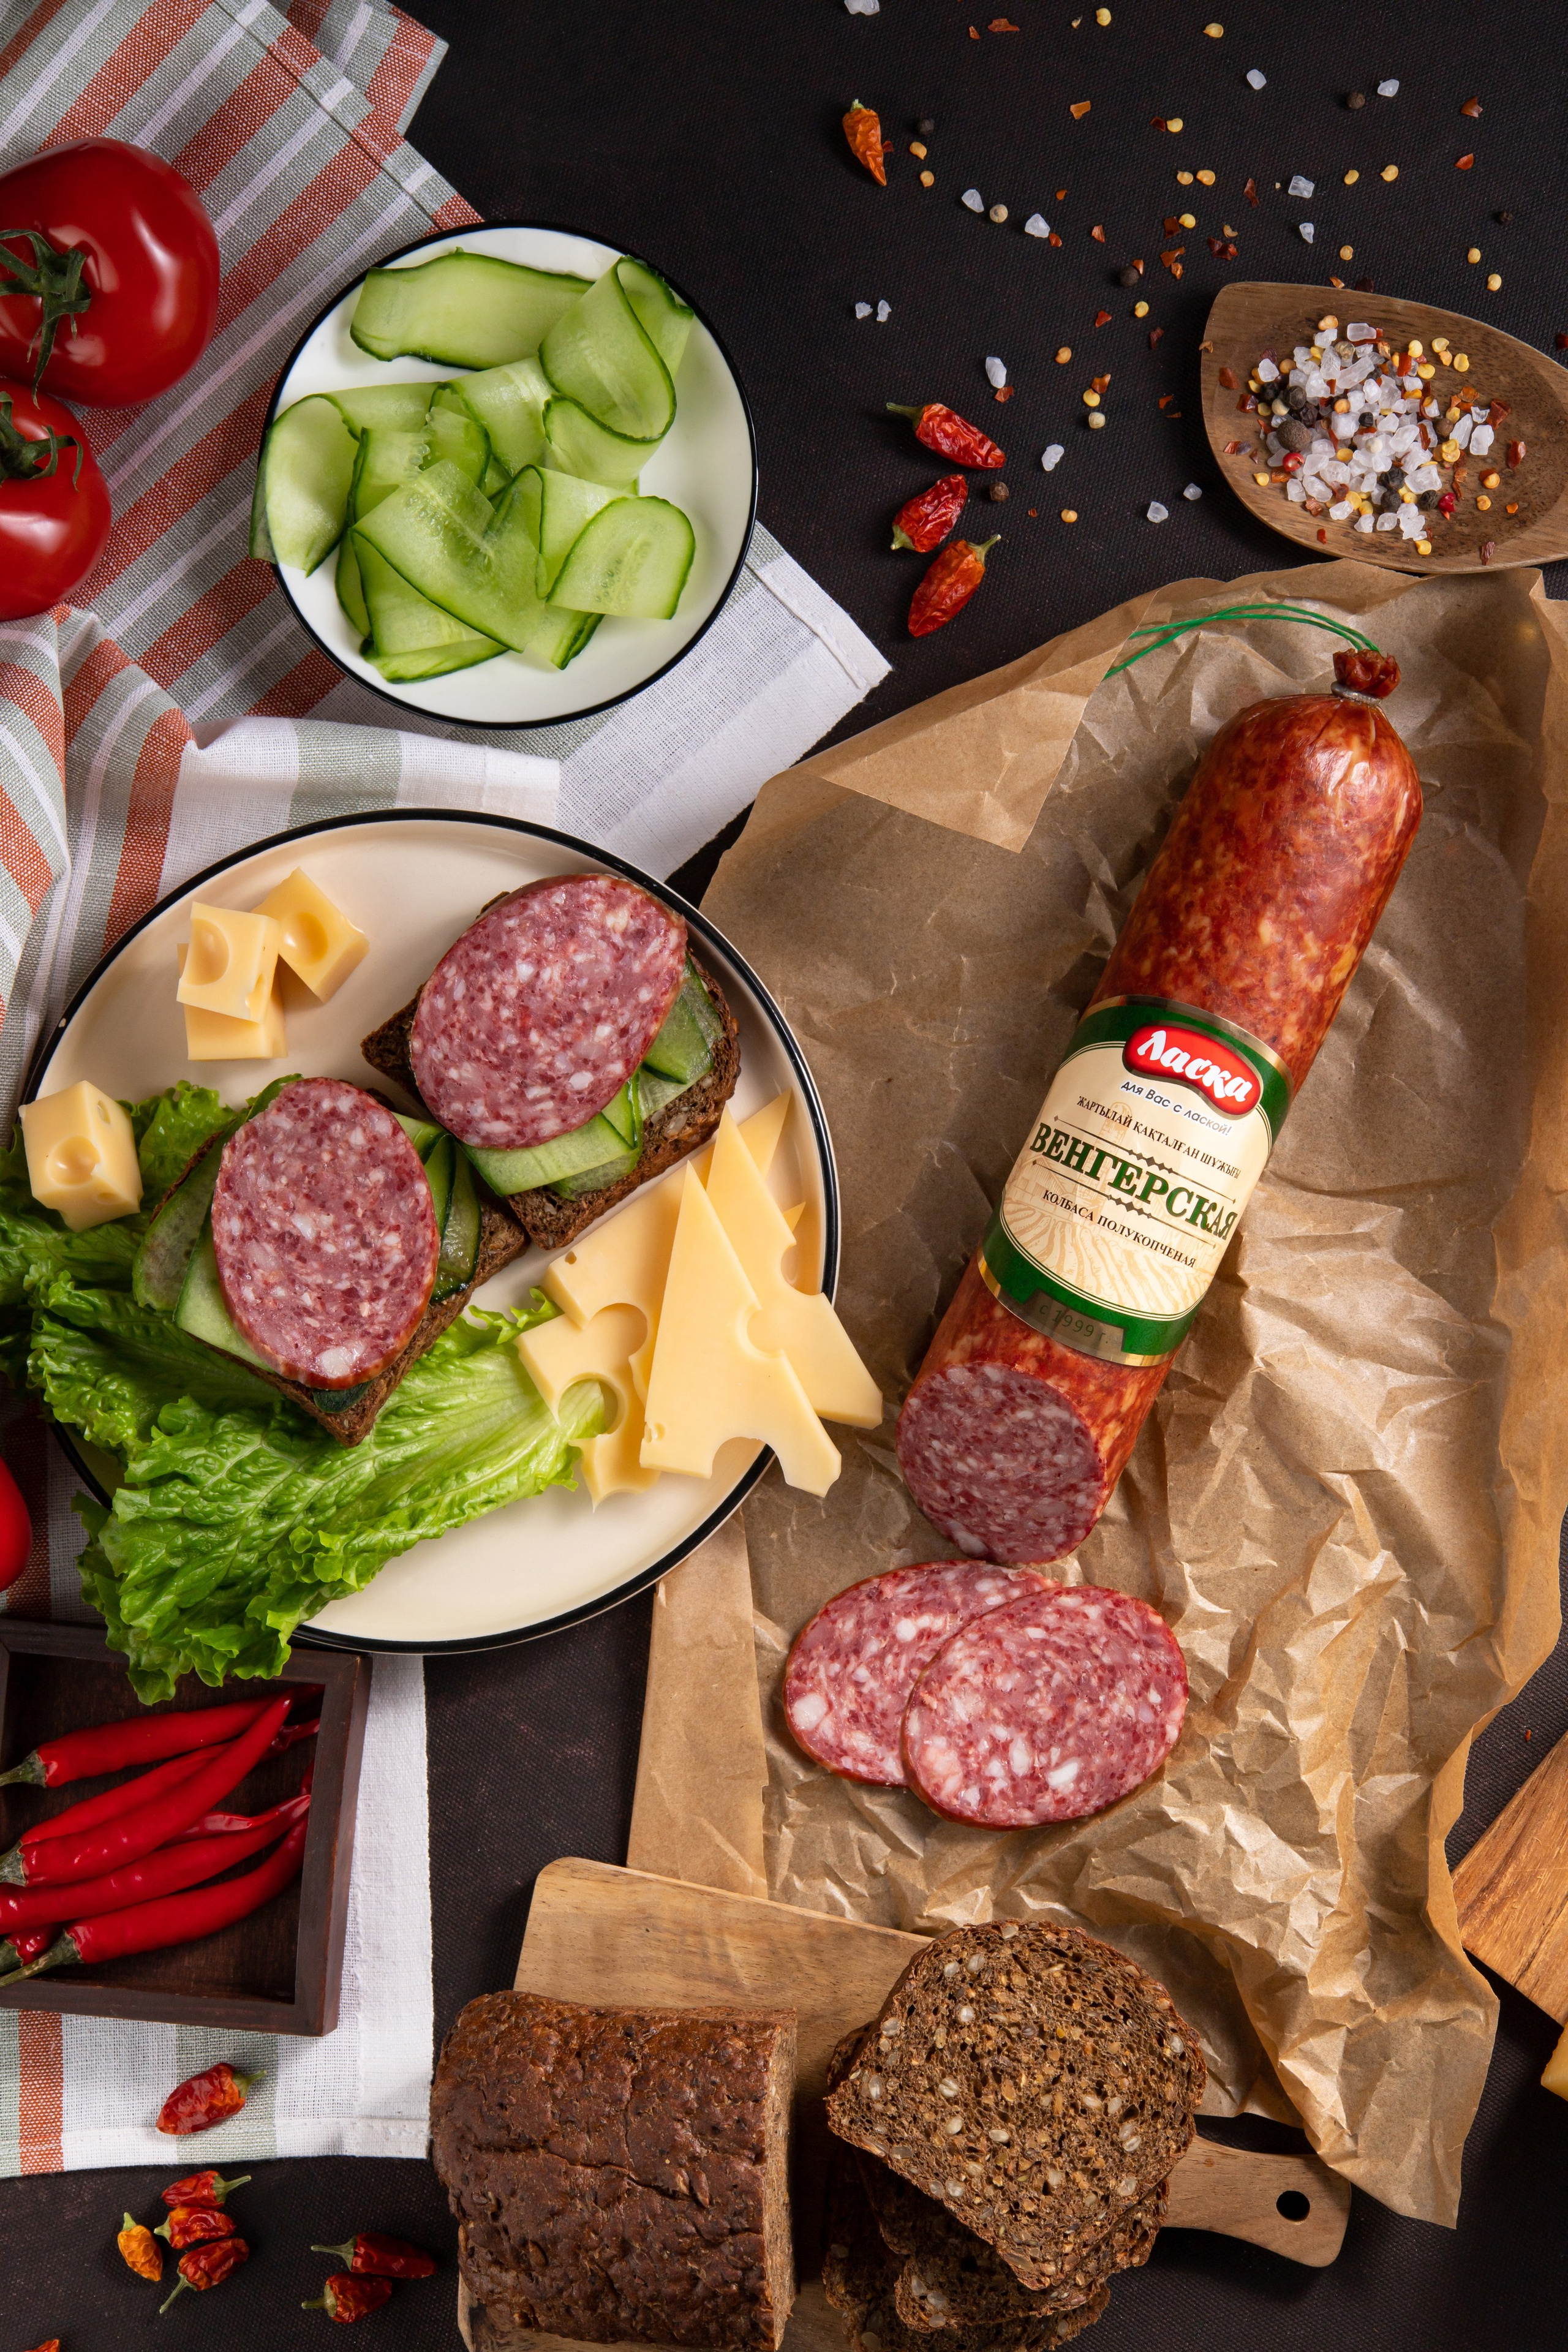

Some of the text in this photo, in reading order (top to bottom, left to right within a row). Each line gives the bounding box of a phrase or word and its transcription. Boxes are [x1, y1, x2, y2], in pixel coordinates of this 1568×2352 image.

[1137, 1030, 1253, 1102] Ласка
[1077, 1095, 1133, 1128] ЖАРТЫЛАЙ
[1133, 1120, 1199, 1157] ҚАҚТАЛҒАН
[1121, 1080, 1232, 1136] для Вас с лаской!
[1029, 1122, 1238, 1240] ВЕНГЕРСКАЯ
[1042, 1189, 1197, 1268] КОЛБАСА ПОЛУКОПЧЕНАЯ
[1051, 1310, 1095, 1338] 1999
